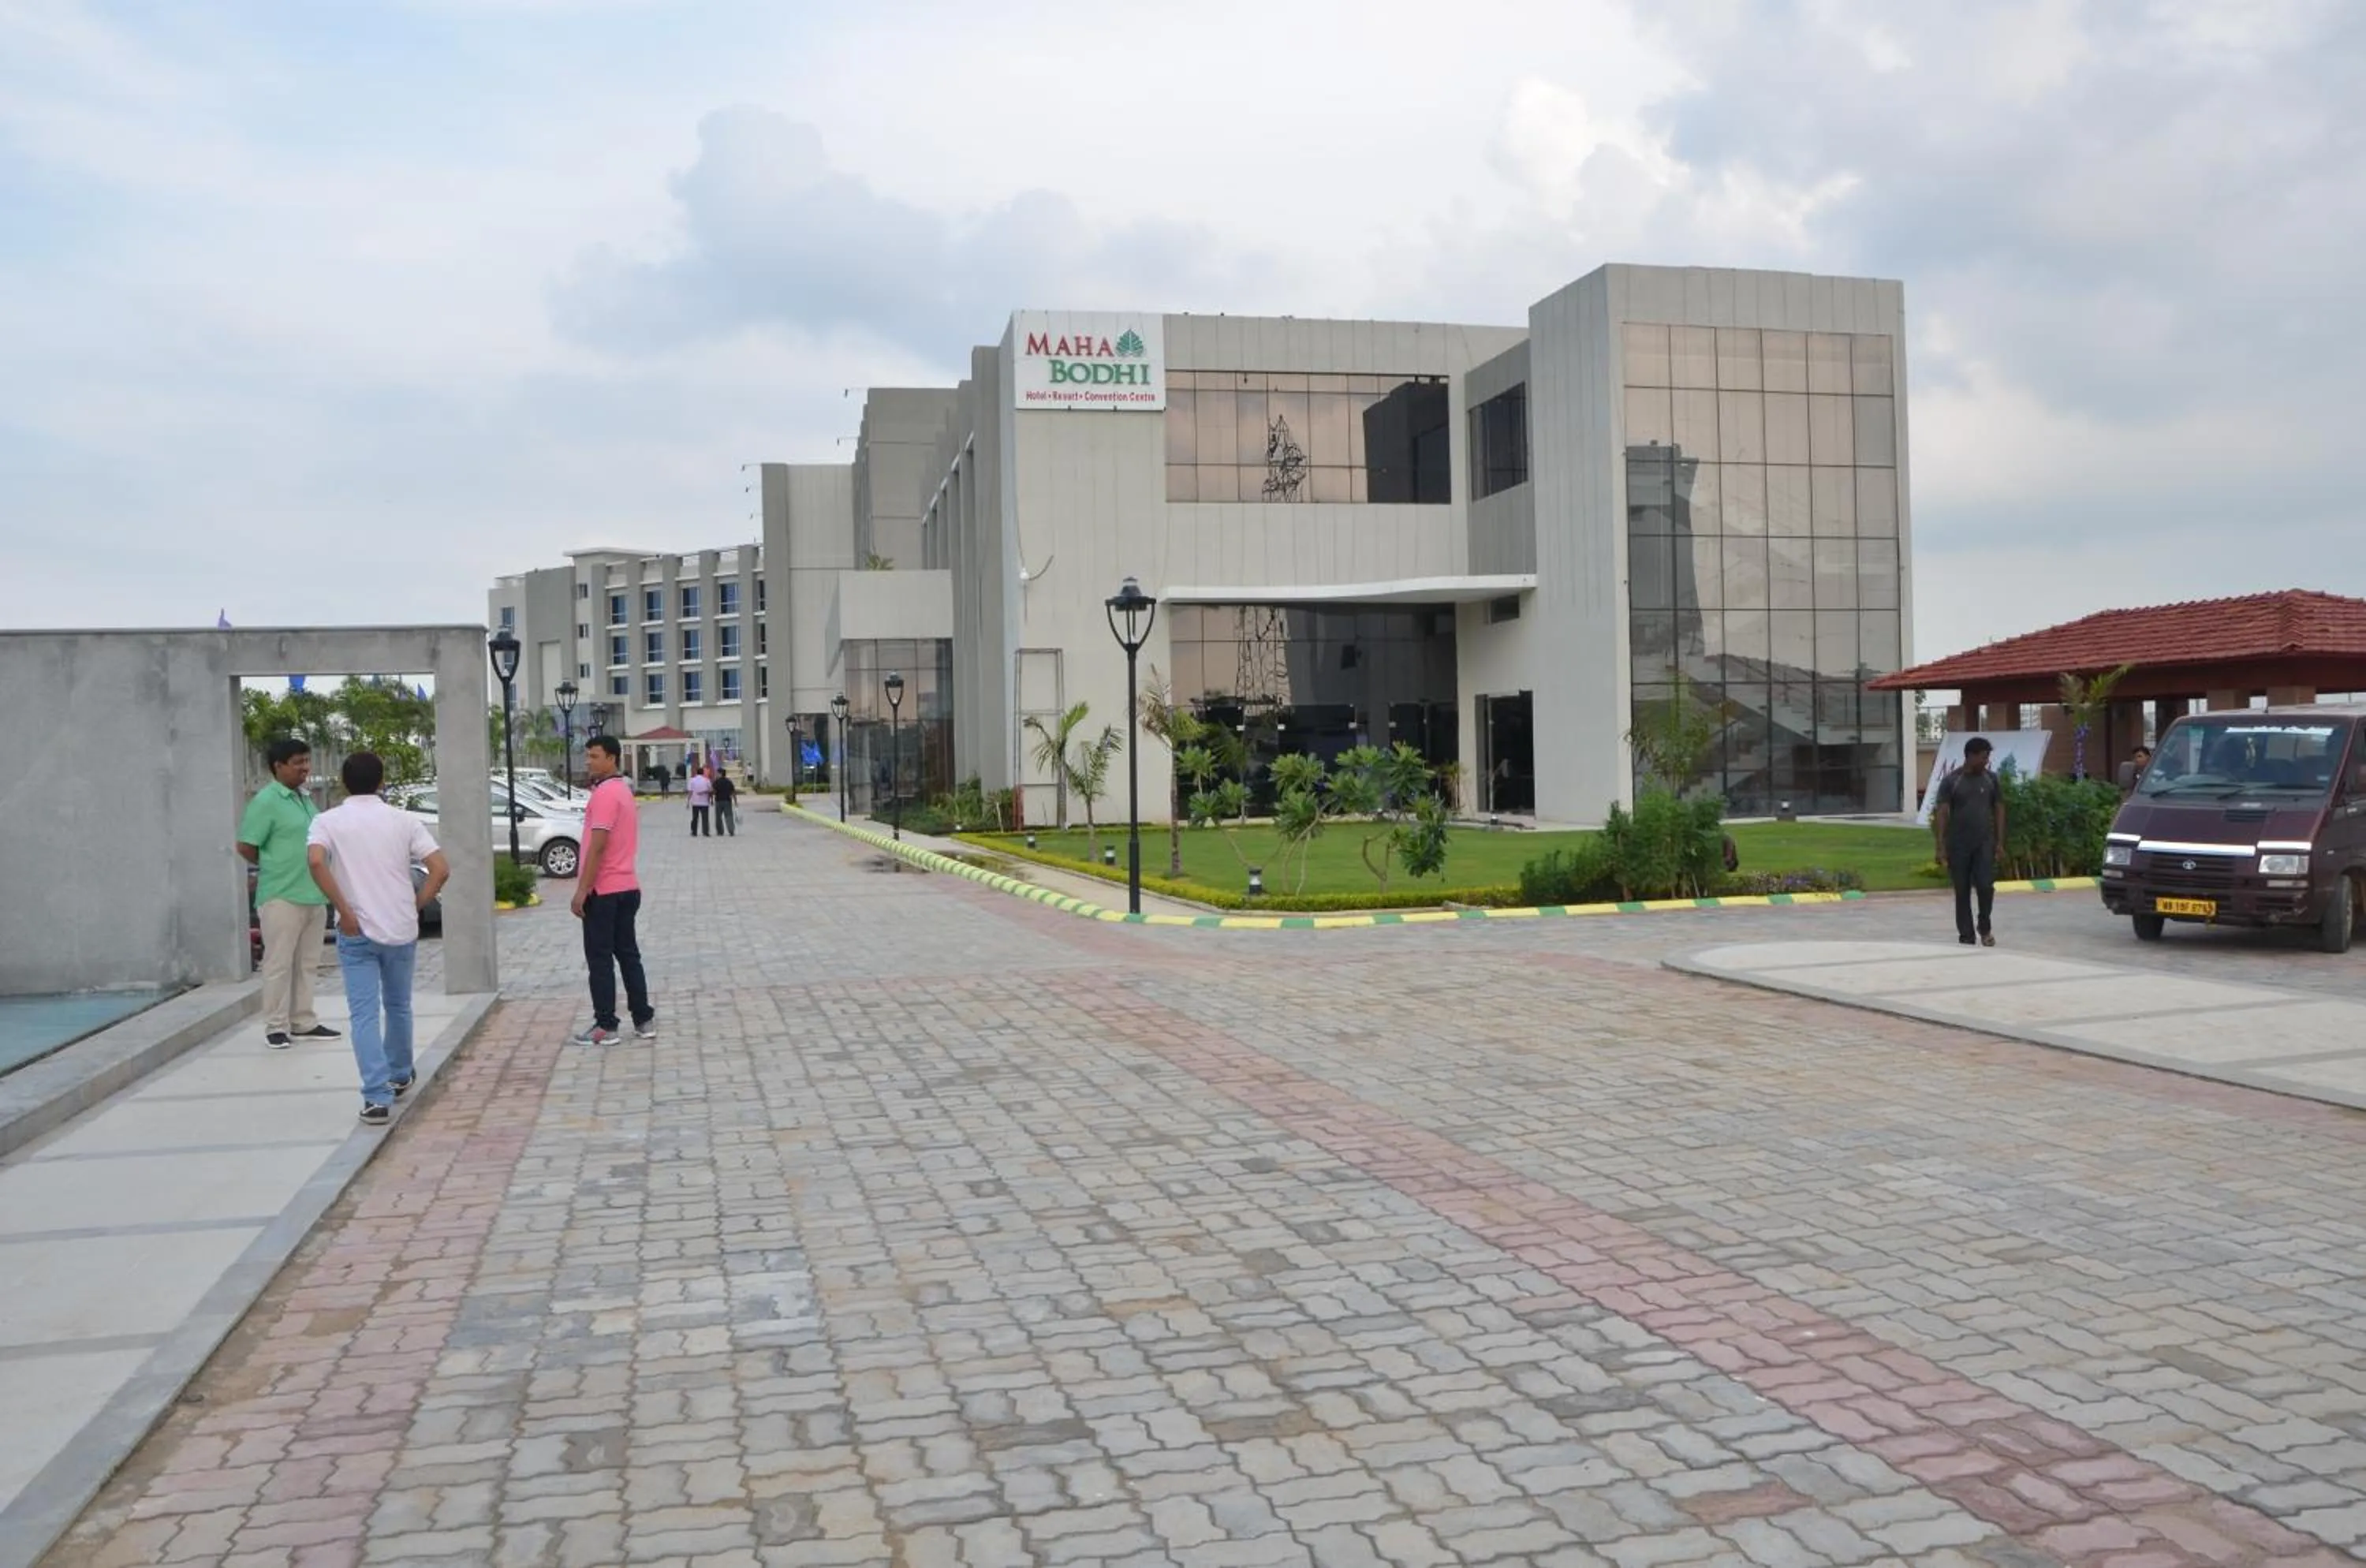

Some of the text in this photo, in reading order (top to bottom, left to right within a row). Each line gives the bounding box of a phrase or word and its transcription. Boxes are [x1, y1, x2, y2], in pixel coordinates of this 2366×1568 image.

[1026, 331, 1114, 357] MAHA
[1048, 359, 1150, 385] BODHI
[1026, 390, 1047, 401] Hotel
[1052, 391, 1078, 401] Resort
[1084, 390, 1128, 402] Convention
